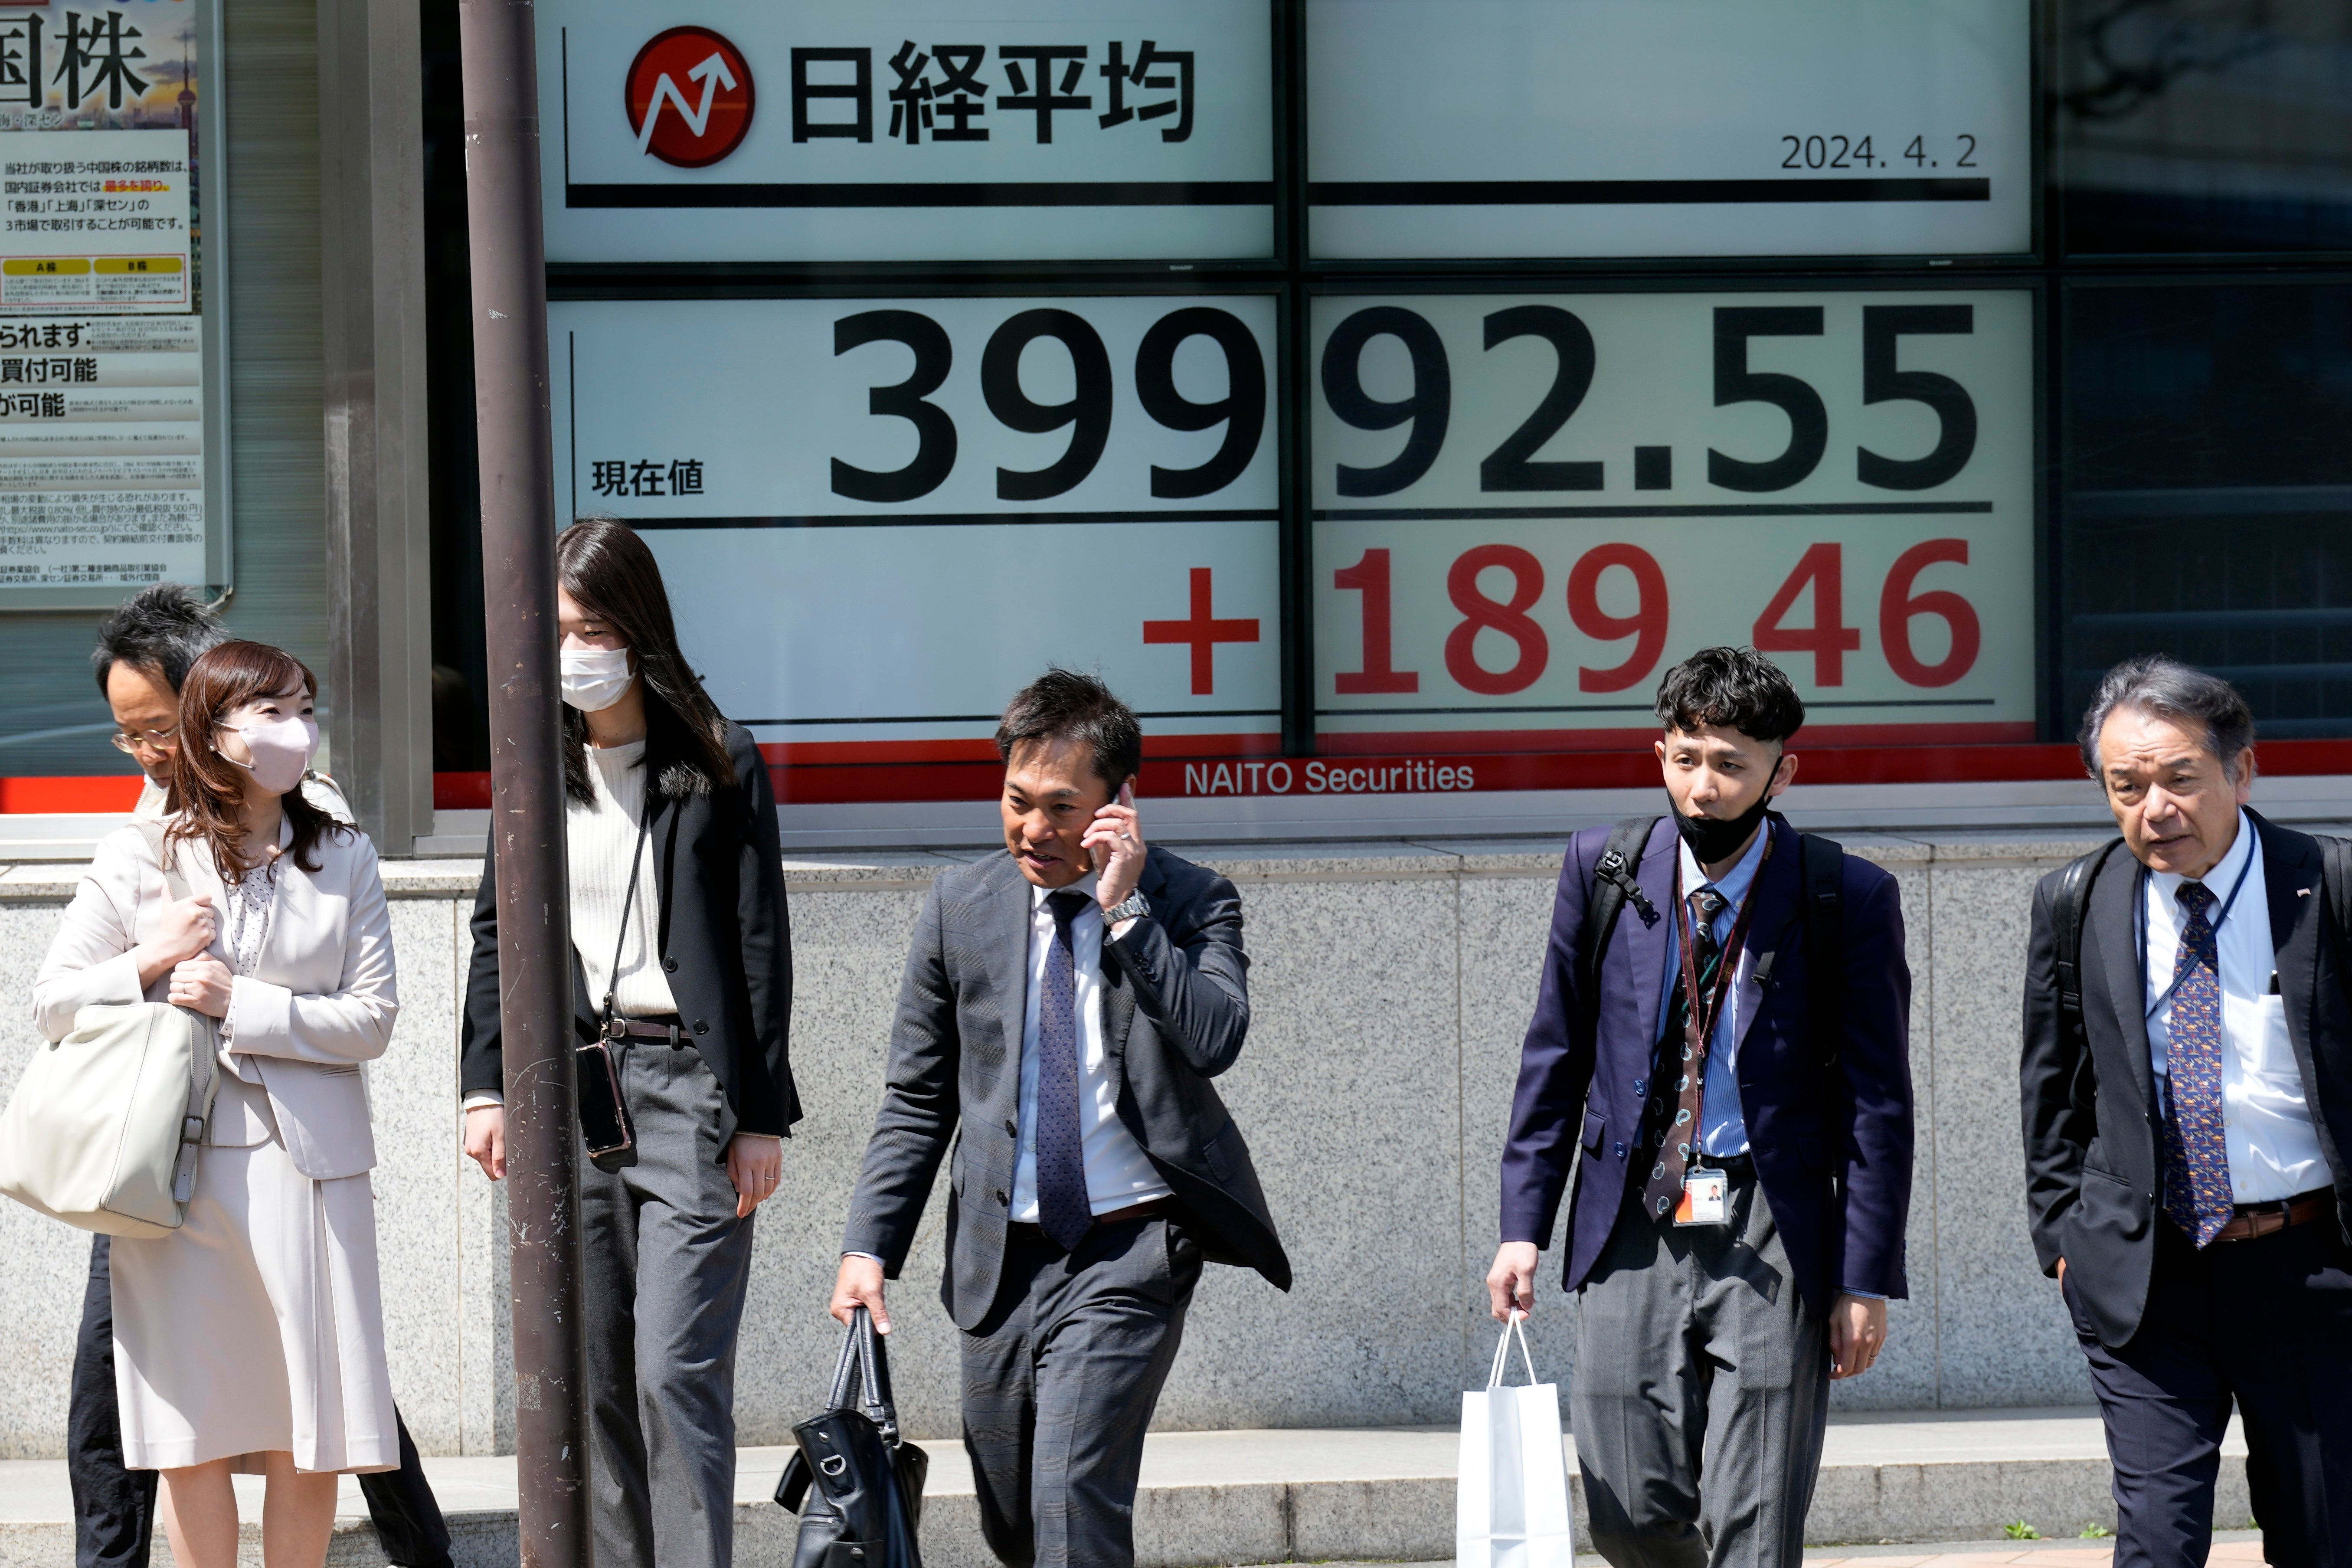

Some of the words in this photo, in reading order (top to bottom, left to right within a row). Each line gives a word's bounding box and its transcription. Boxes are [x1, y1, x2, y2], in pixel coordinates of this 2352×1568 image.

[791, 39, 1195, 144] 日経平均
[1781, 135, 1886, 169] 2024.
[1904, 135, 1938, 168] 4.
[1956, 134, 1977, 168] 2
[1, 357, 97, 383] 買付可能
[830, 304, 1978, 502] 39992.55
[592, 459, 703, 497] 現在値
[1185, 762, 1292, 794] NAITO
[1305, 759, 1475, 792] Securities
